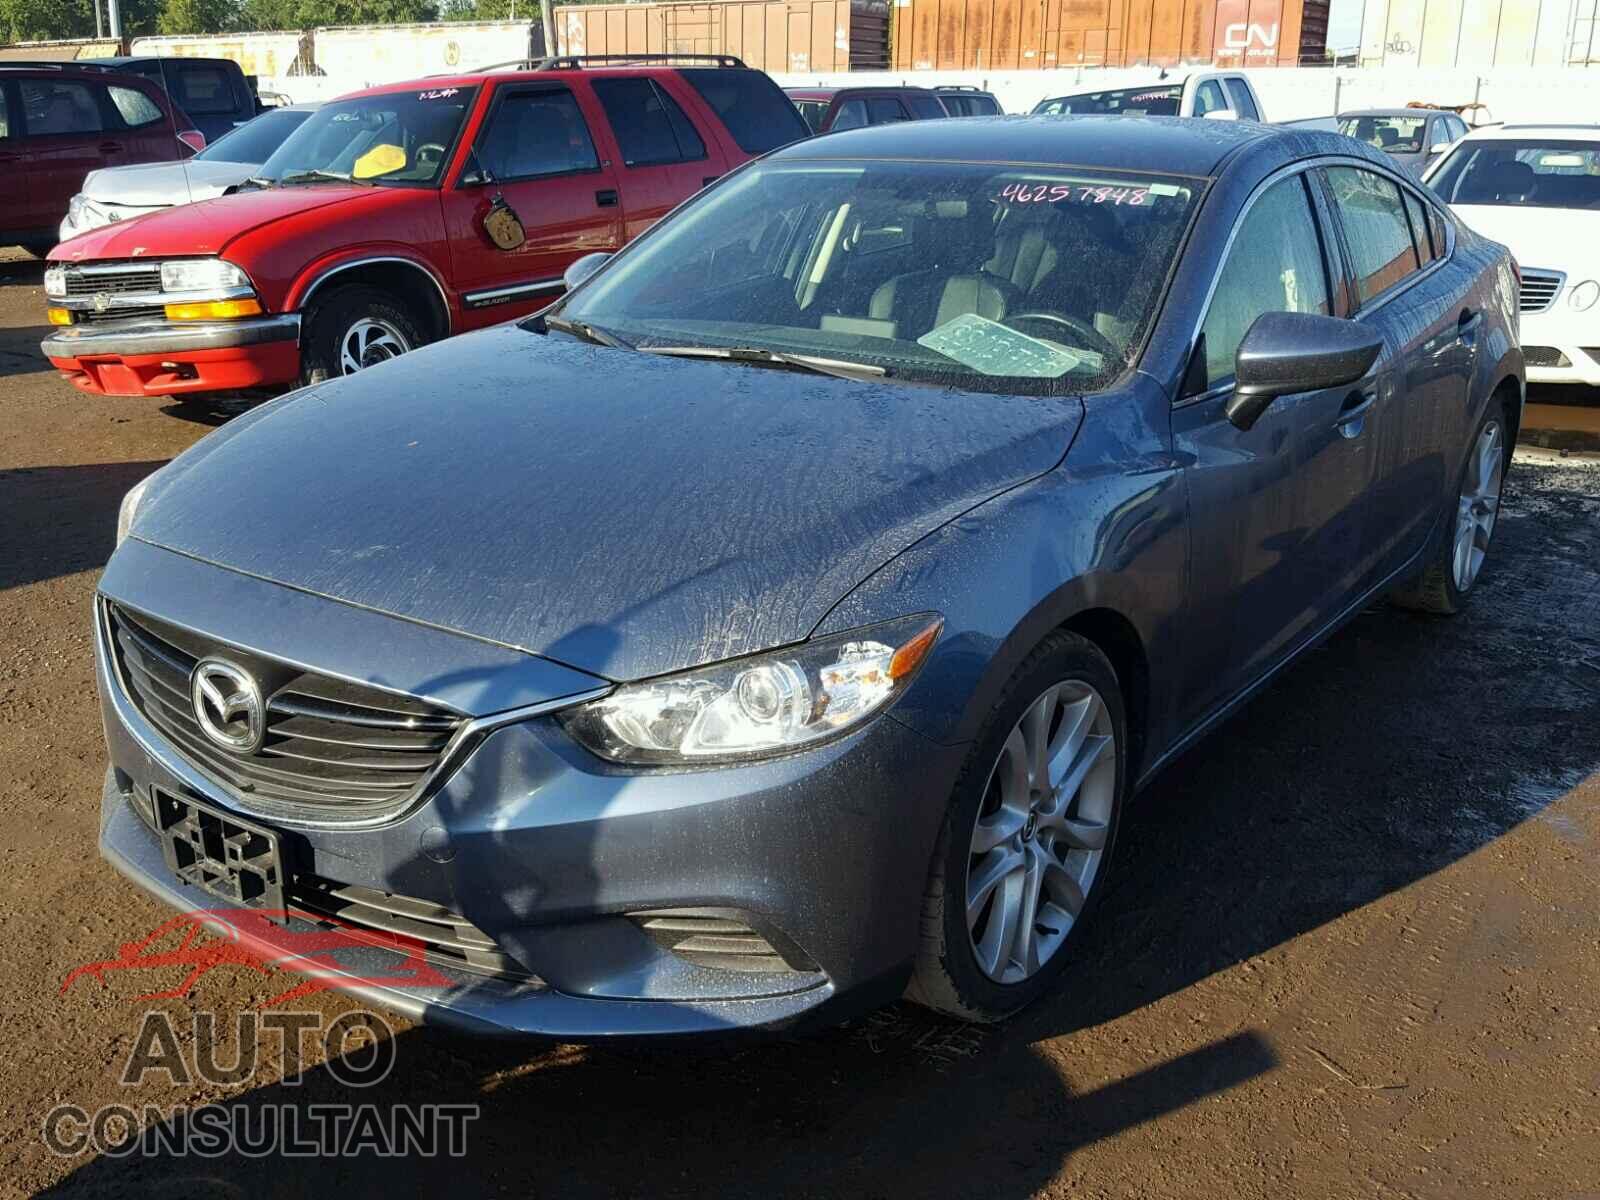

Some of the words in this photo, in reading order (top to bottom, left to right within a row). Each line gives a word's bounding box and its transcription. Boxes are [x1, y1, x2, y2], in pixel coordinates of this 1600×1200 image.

[1226, 22, 1277, 47] CN
[1001, 183, 1069, 202] 4625
[1079, 187, 1150, 205] 7848
